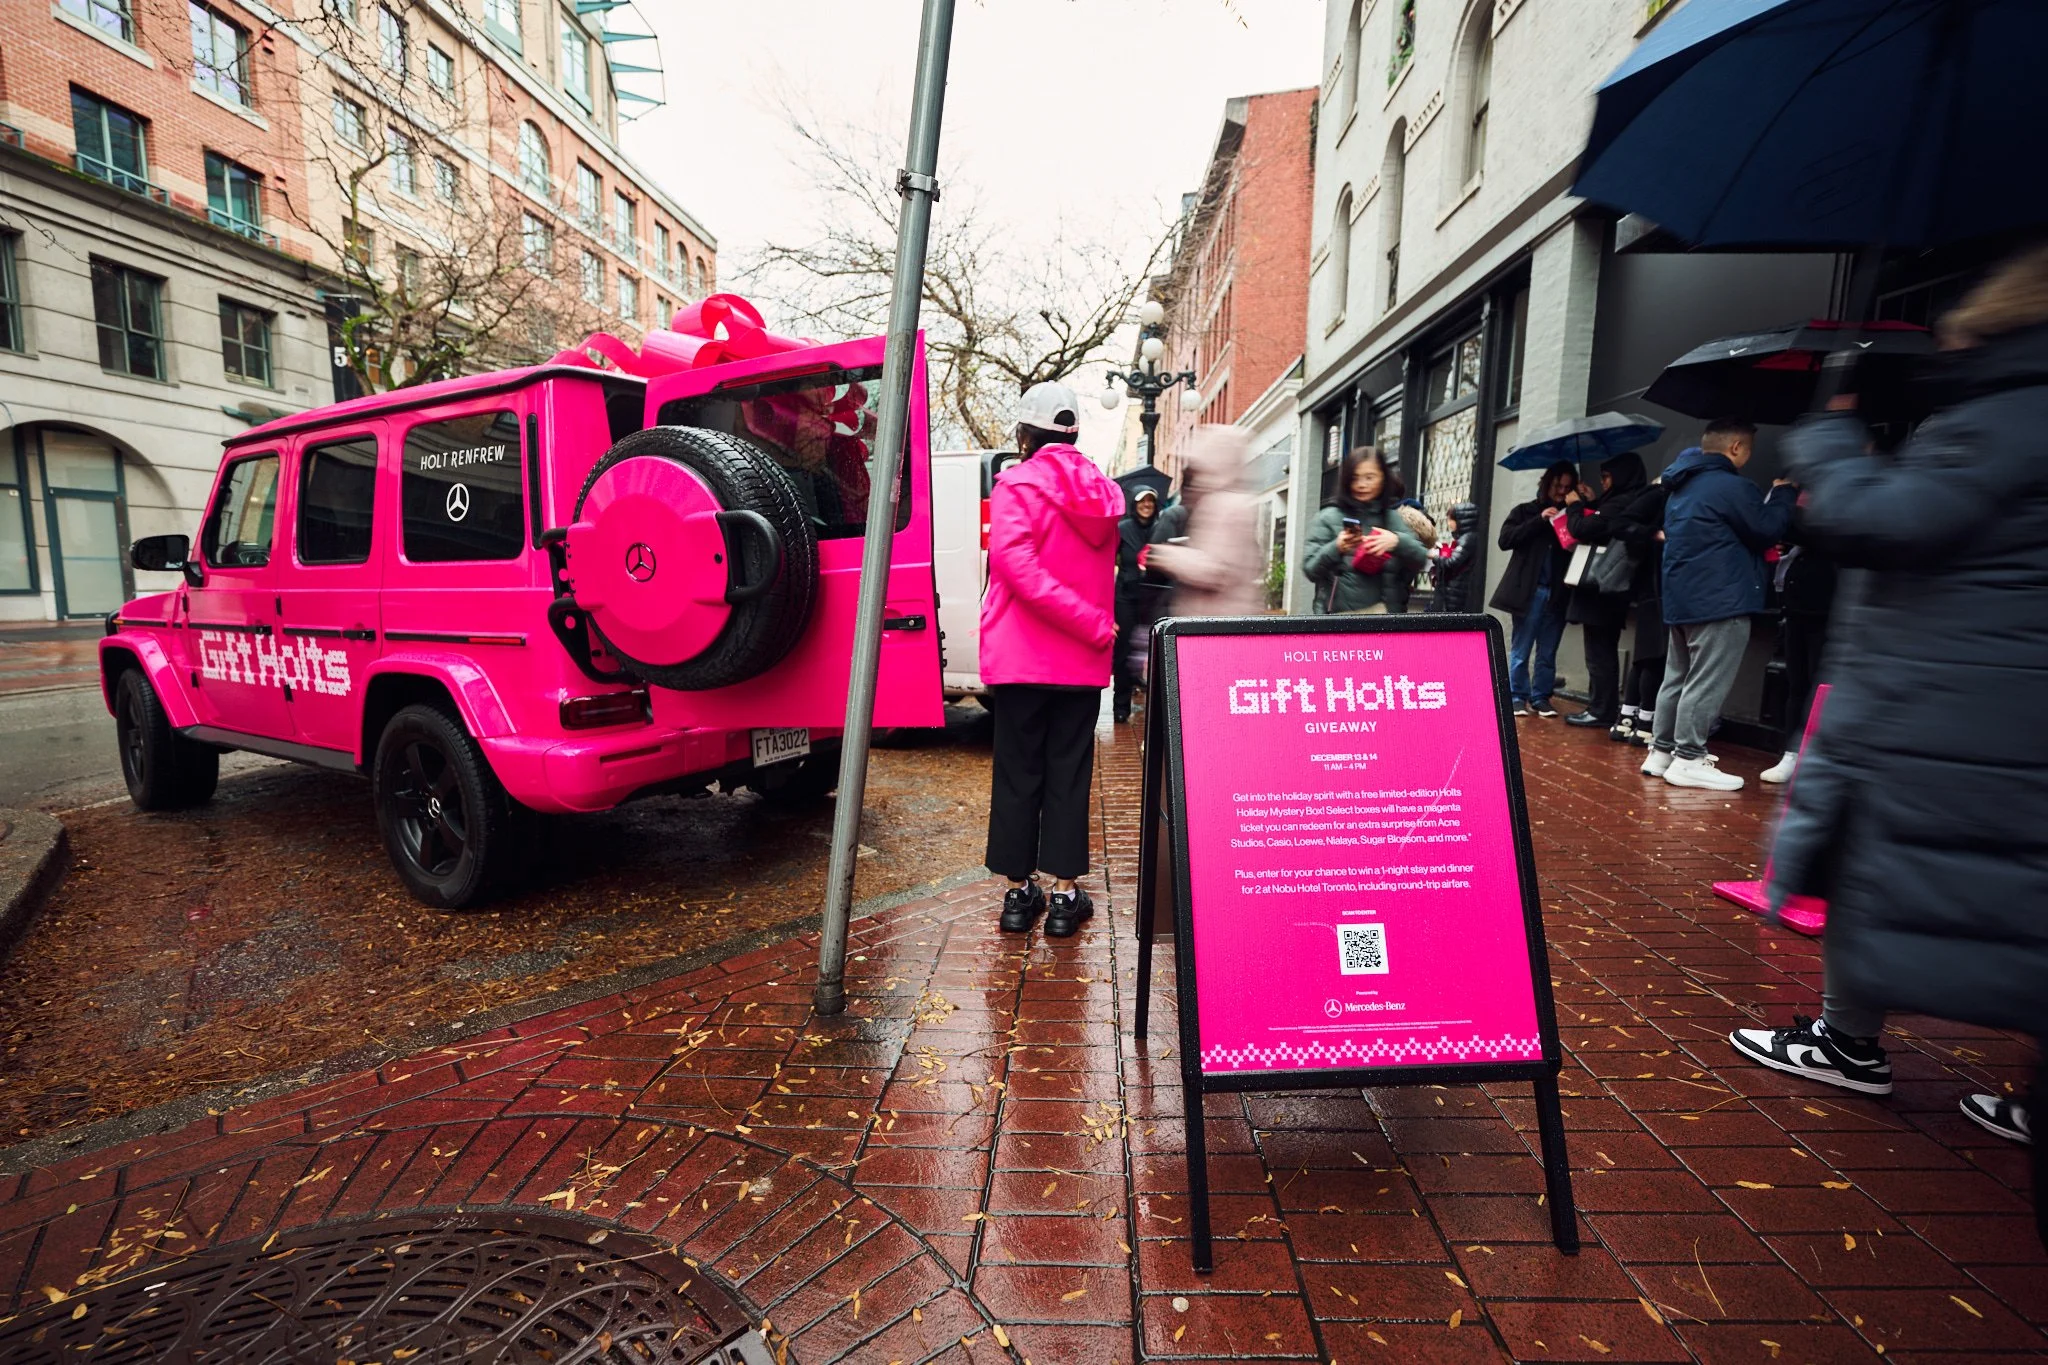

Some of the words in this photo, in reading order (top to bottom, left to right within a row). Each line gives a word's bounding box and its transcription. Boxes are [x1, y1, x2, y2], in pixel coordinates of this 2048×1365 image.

[420, 452, 449, 471] HOLT
[450, 444, 506, 469] RENFREW
[1284, 651, 1318, 662] HOLT
[1323, 649, 1385, 662] RENFREW
[199, 630, 256, 685] Gift
[255, 634, 352, 697] Holts
[1229, 678, 1317, 714] Gift
[1325, 675, 1447, 712] Holts
[1304, 721, 1377, 733] GIVEAWAY
[755, 728, 808, 758] FTA3022
[1310, 753, 1353, 762] DECEMBER
[1323, 763, 1330, 771] 11
[1354, 762, 1367, 770] PM
[1232, 792, 1249, 802] Get
[1249, 792, 1266, 801] into
[1267, 792, 1282, 801] the
[1282, 791, 1312, 802] holiday
[1313, 790, 1334, 801] spirit
[1335, 790, 1353, 799] with
[1361, 790, 1378, 798] free
[1379, 788, 1438, 798] limited-edition
[1439, 788, 1462, 797] Holts
[1236, 808, 1268, 818] Holiday
[1269, 807, 1304, 818] Mystery
[1305, 806, 1325, 815] Box!
[1325, 805, 1354, 815] Select
[1354, 804, 1380, 814] boxes
[1381, 804, 1395, 813] will
[1395, 803, 1416, 812] have
[1424, 803, 1461, 813] magenta
[1240, 823, 1263, 832] ticket
[1264, 823, 1281, 833] you
[1282, 823, 1298, 831] can
[1299, 821, 1332, 831] redeem
[1333, 821, 1345, 830] for
[1346, 821, 1357, 829] an
[1358, 820, 1379, 829] extra
[1380, 819, 1416, 830] surprise
[1416, 819, 1437, 828] from
[1438, 818, 1460, 827] Acne
[1231, 837, 1266, 848] Studios,
[1266, 837, 1293, 847] Casio,
[1294, 836, 1326, 847] Loewe,
[1326, 835, 1360, 847] Nialaya,
[1360, 834, 1386, 846] Sugar
[1387, 834, 1427, 844] Blossom,
[1427, 833, 1444, 843] and
[1234, 869, 1256, 879] Plus,
[1256, 869, 1279, 878] enter
[1280, 868, 1293, 877] for
[1294, 868, 1313, 879] your
[1314, 867, 1347, 877] chance
[1348, 867, 1357, 876] to
[1358, 866, 1374, 875] win
[1381, 865, 1409, 876] 1-night
[1410, 865, 1429, 875] stay
[1429, 864, 1446, 873] and
[1446, 863, 1474, 873] dinner
[1241, 885, 1254, 895] for
[1255, 885, 1262, 894] 2
[1262, 885, 1271, 894] at
[1272, 884, 1297, 894] Nobu
[1297, 883, 1321, 893] Hotel
[1322, 882, 1357, 892] Toronto,
[1357, 881, 1397, 892] including
[1397, 880, 1440, 891] round-trip
[1441, 879, 1471, 889] airfare.
[1345, 1001, 1406, 1012] Mercedes-Benz
